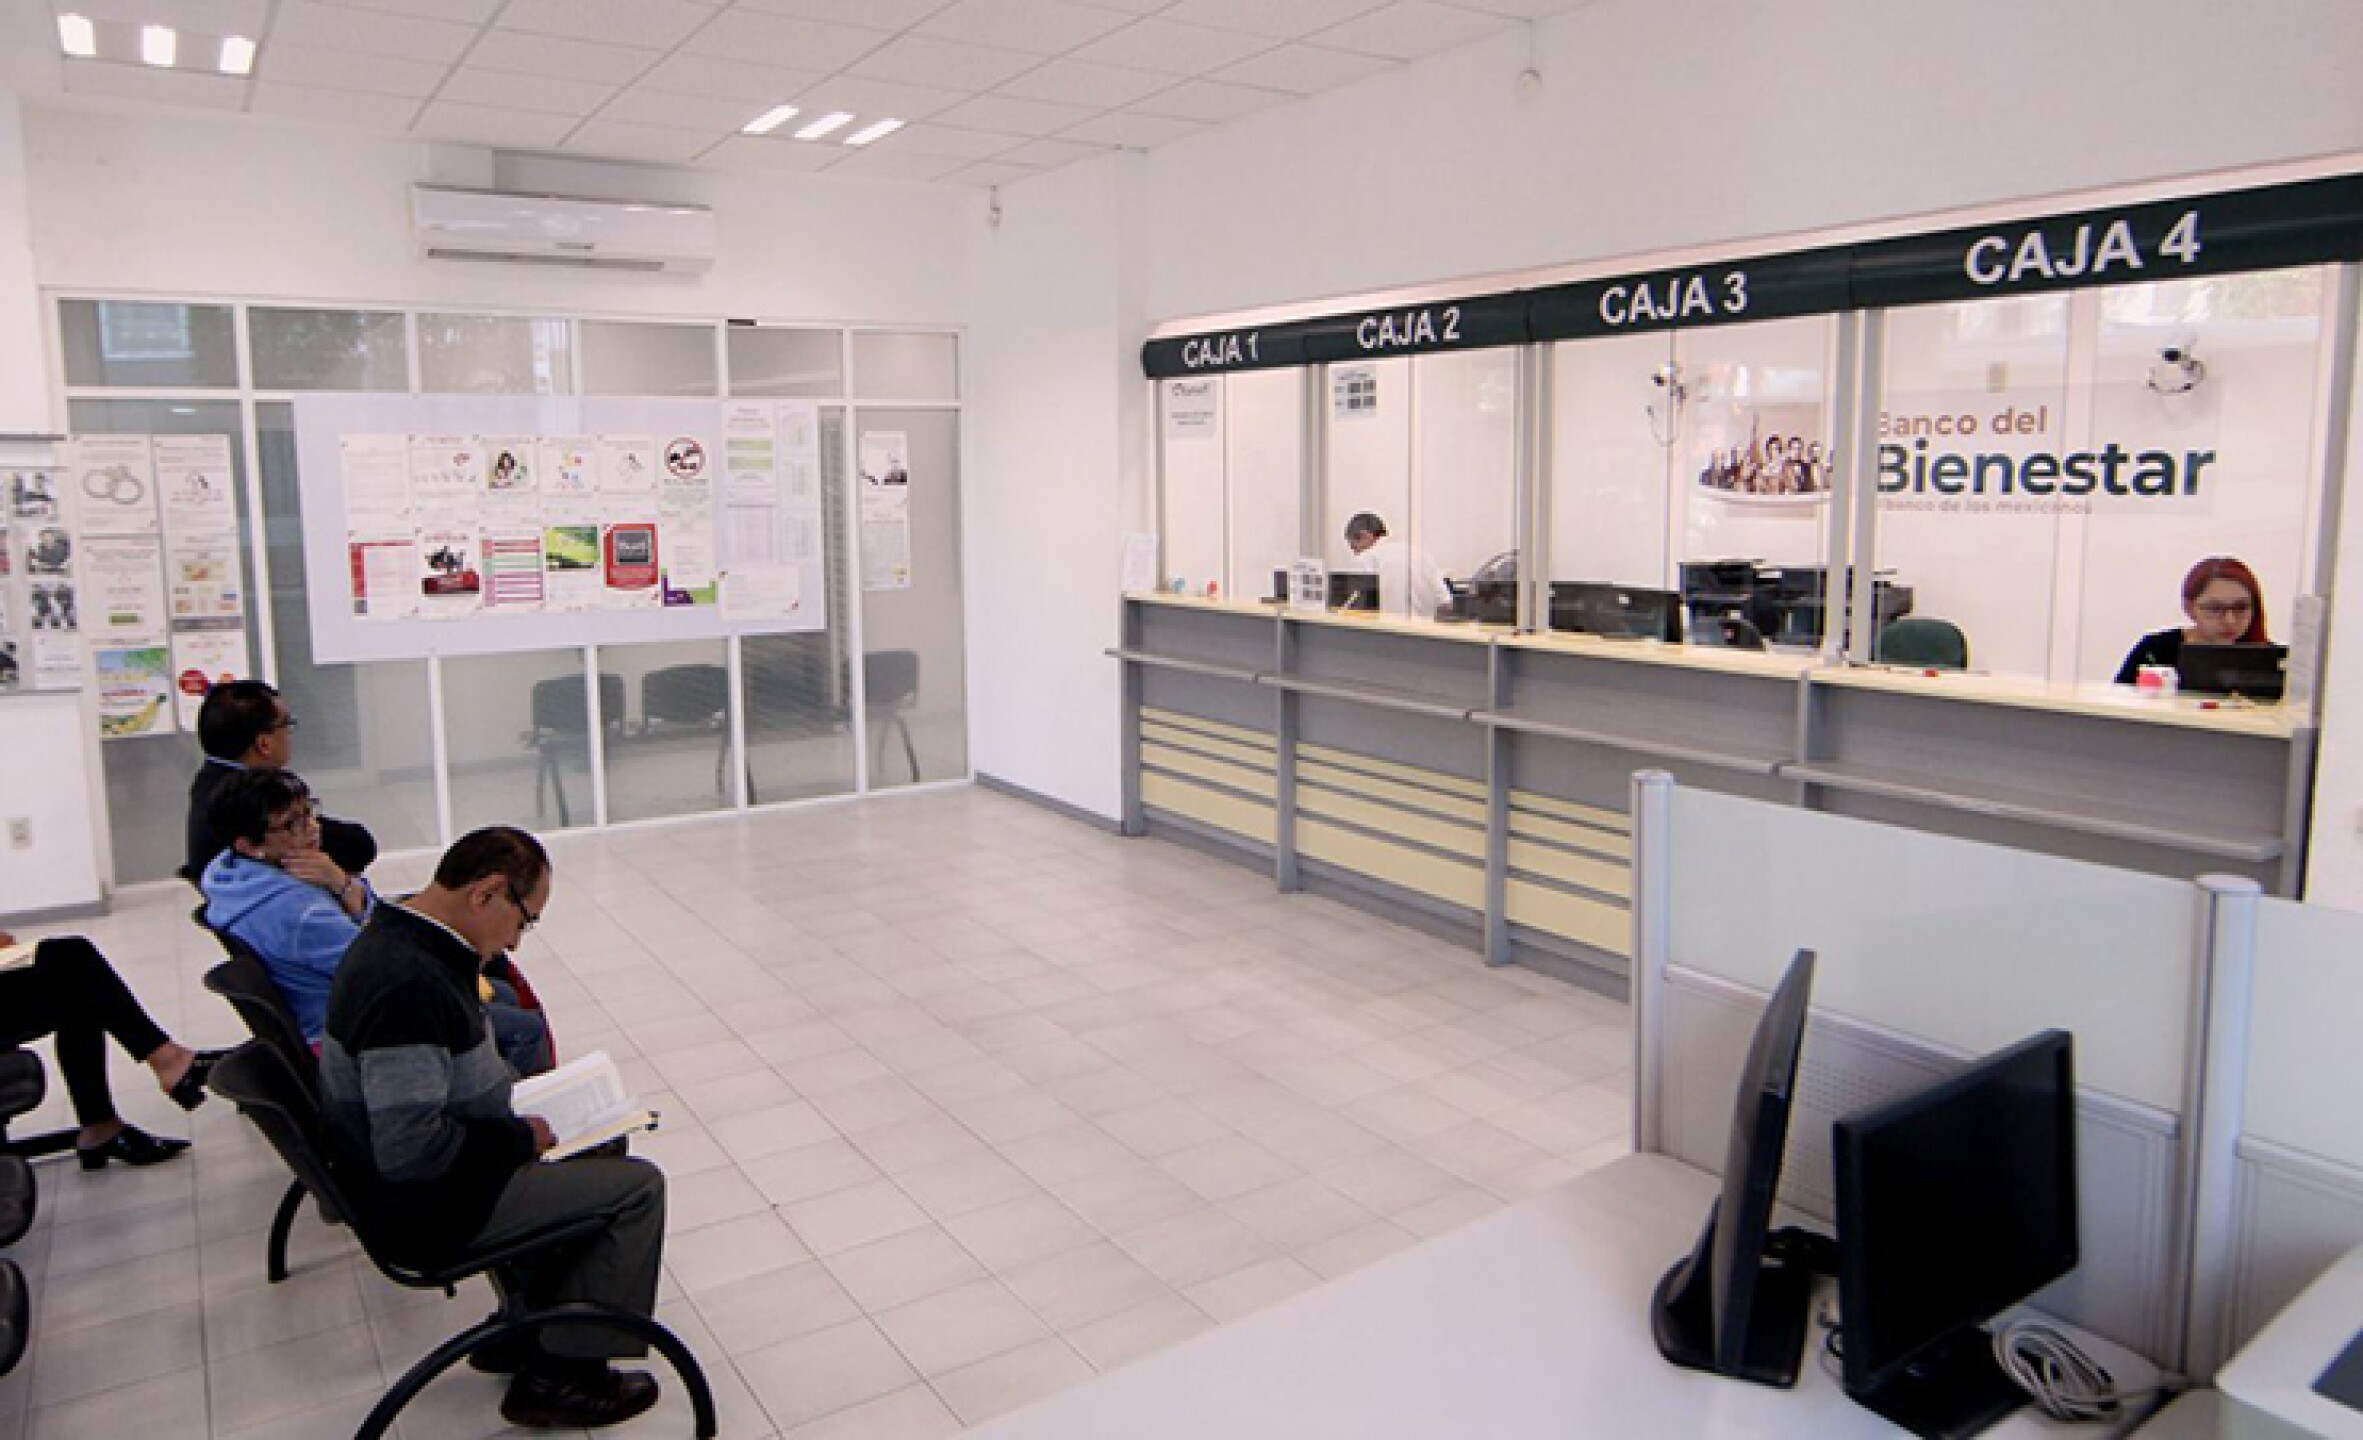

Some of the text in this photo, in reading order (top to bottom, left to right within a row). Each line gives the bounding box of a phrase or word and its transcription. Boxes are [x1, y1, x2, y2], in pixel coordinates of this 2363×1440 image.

[1965, 211, 2200, 285] CAJA 4
[1601, 271, 1748, 325] CAJA 3
[1181, 331, 1259, 367] CAJA 1
[1356, 306, 1461, 349] CAJA 2
[1992, 405, 2048, 435] del
[1877, 437, 2217, 496] Bienestar
